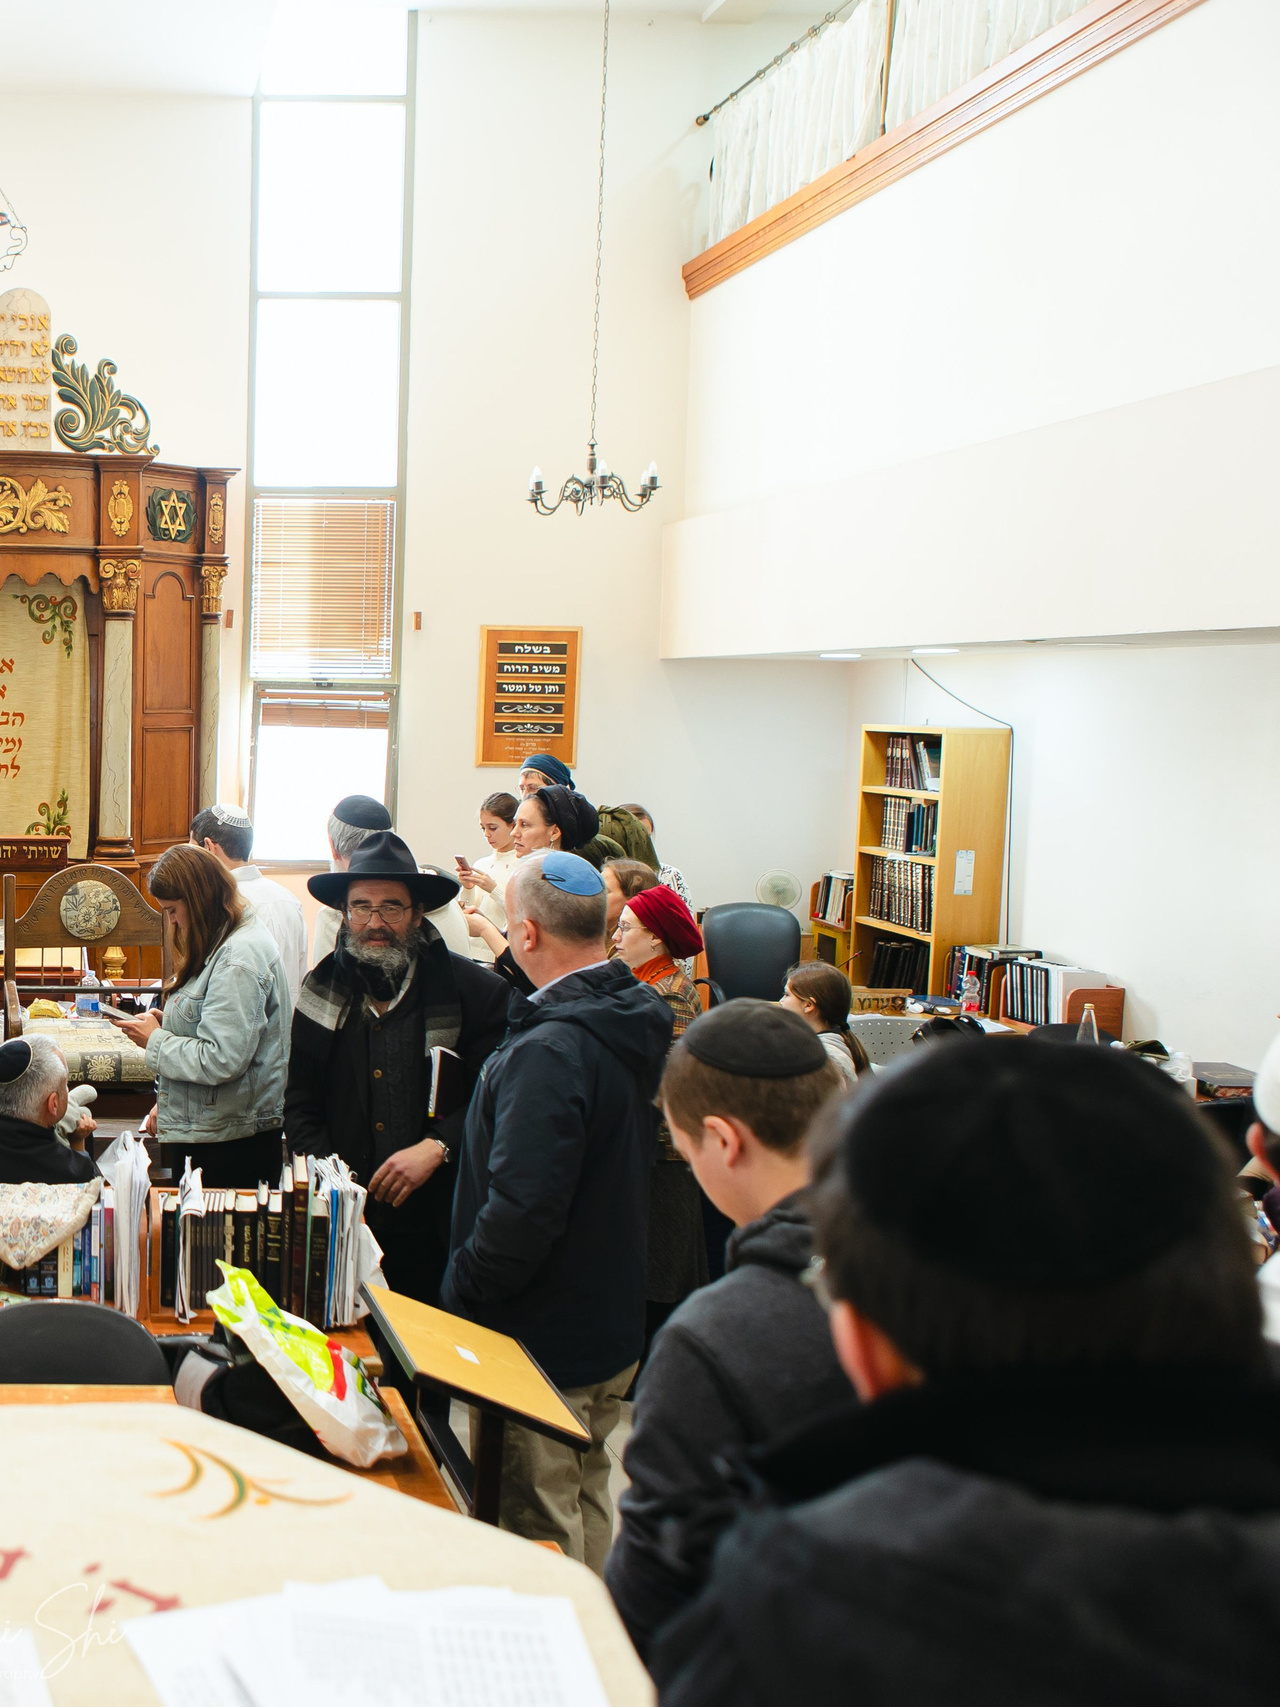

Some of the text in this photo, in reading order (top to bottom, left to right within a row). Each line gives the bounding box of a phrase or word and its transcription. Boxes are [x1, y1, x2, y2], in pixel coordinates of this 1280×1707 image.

[11, 314, 50, 331] אנכי
[31, 334, 50, 357] לא
[31, 360, 50, 384] לא
[22, 394, 49, 411] זכור
[22, 422, 50, 438] כבד
[514, 644, 551, 654] בשלח
[503, 664, 560, 673] משיב הרוח
[502, 683, 559, 694] ותן טל ומטר
[23, 845, 62, 859] שויתי
[858, 997, 890, 1011] ערוץ
